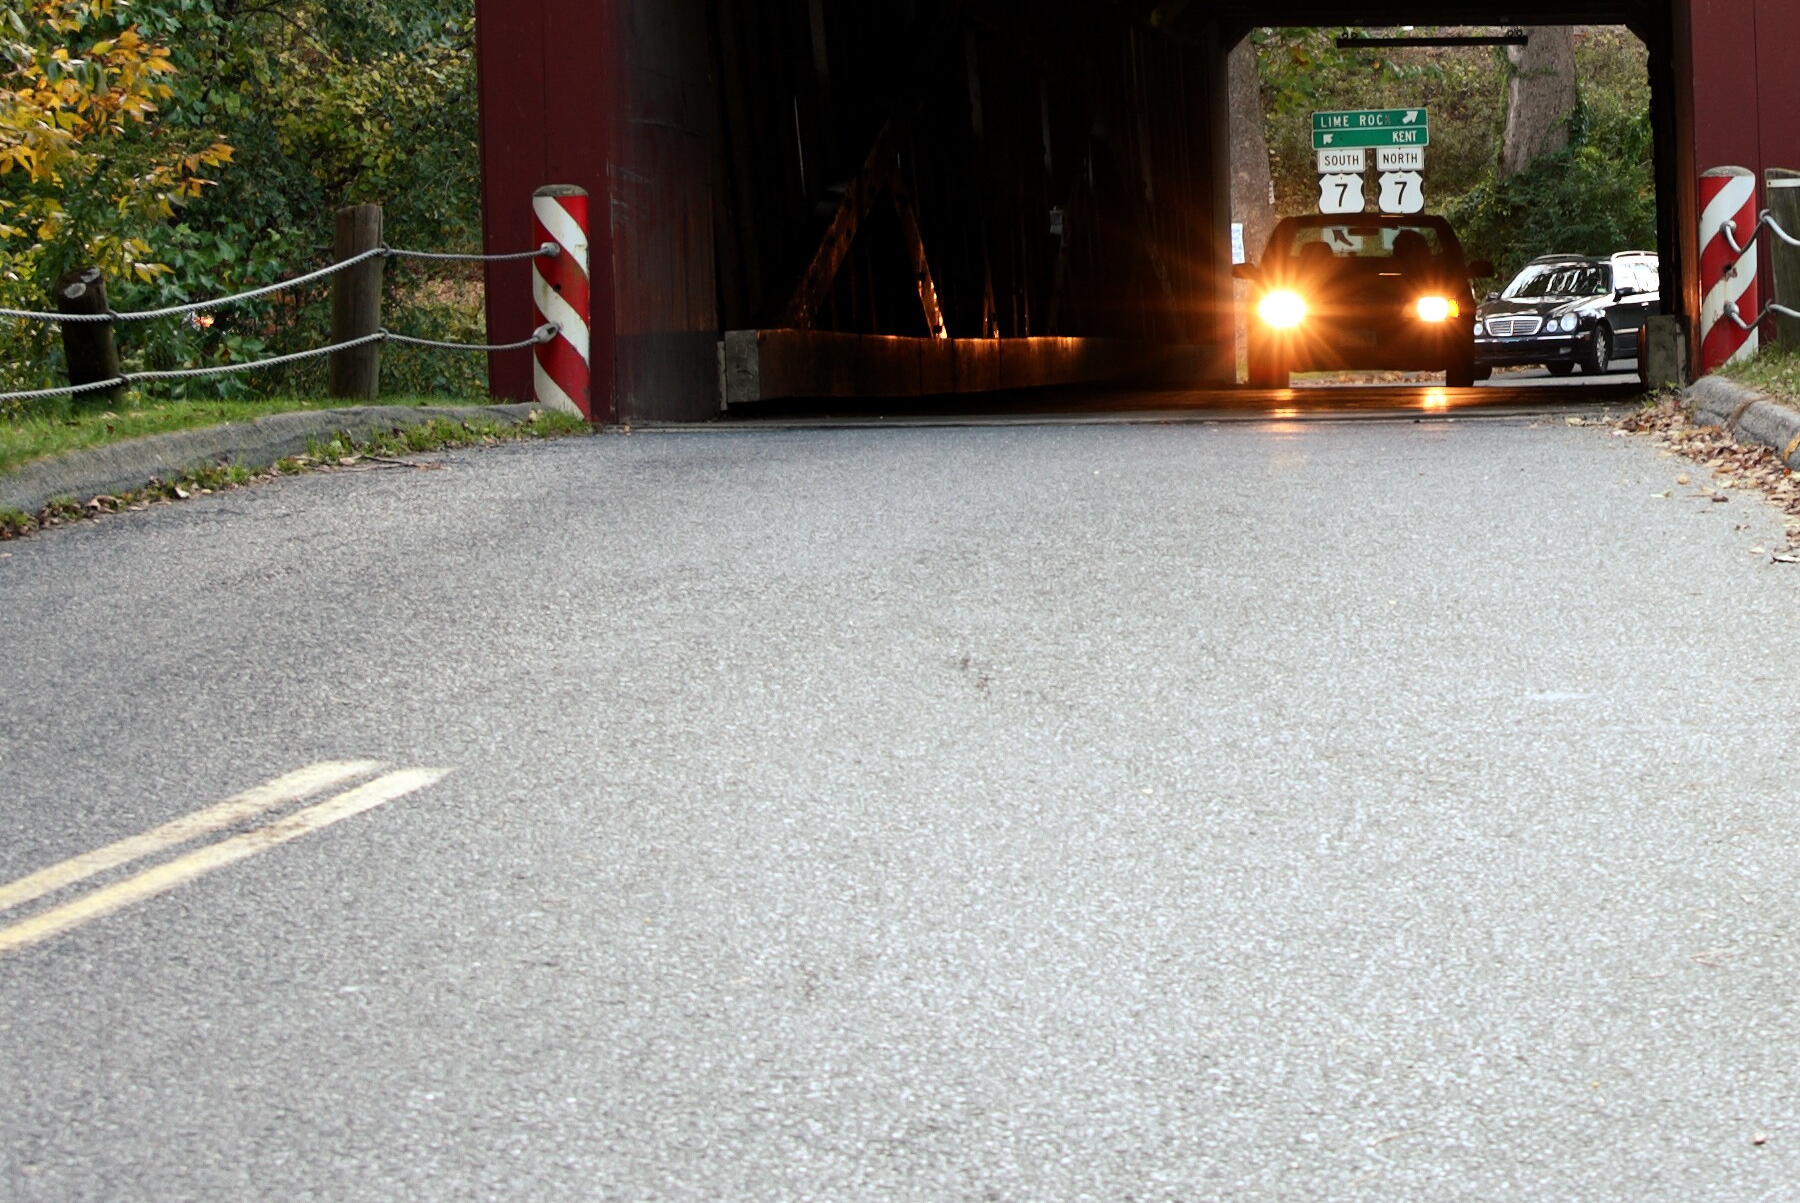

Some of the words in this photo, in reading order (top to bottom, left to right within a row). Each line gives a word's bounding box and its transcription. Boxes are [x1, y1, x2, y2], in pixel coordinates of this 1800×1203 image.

[1320, 115, 1350, 128] LIME
[1392, 130, 1417, 143] KENT
[1324, 155, 1359, 166] SOUTH
[1383, 153, 1418, 165] NORTH
[1335, 183, 1349, 208] 7
[1394, 181, 1408, 205] 7
